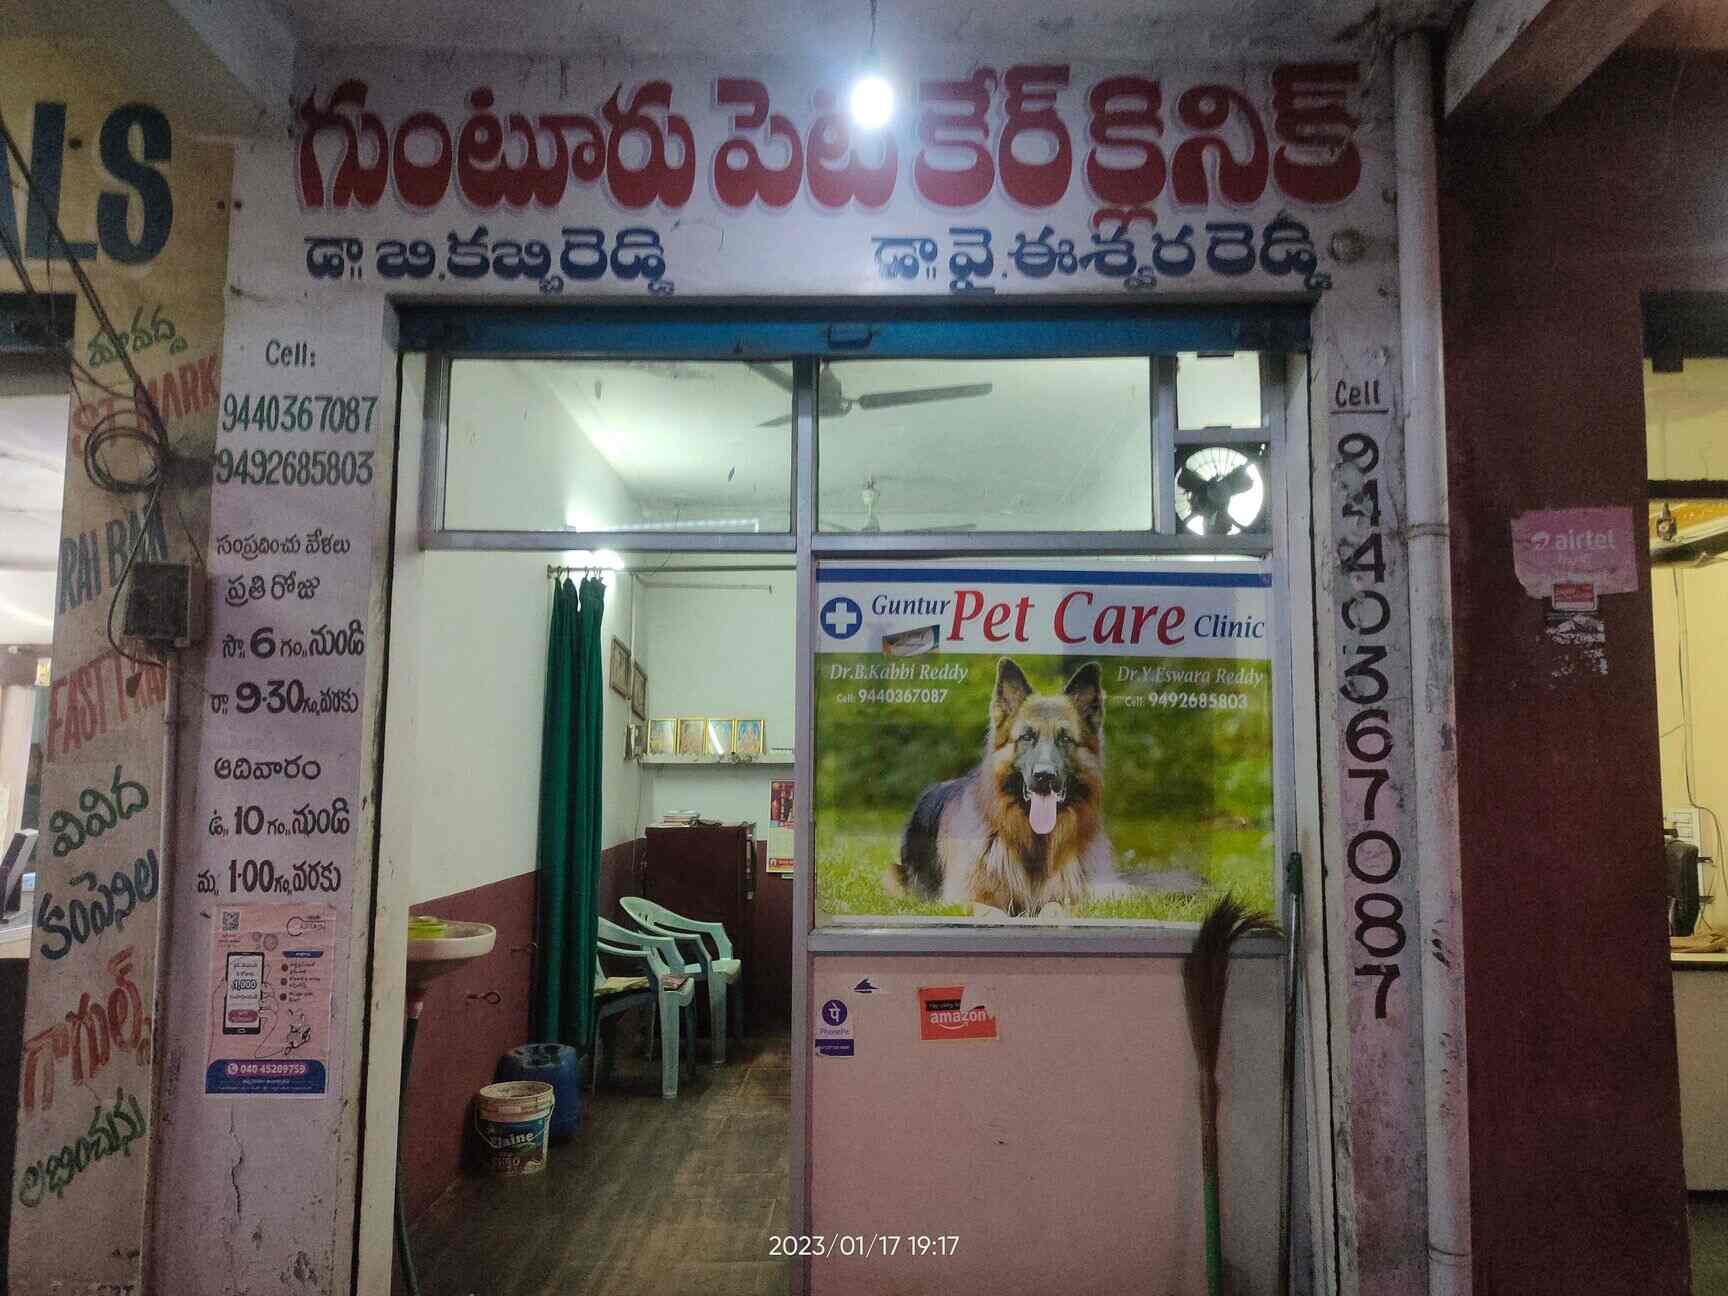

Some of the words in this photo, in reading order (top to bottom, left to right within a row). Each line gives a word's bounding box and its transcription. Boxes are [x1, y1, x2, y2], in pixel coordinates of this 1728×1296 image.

[298, 79, 697, 209] గుంటూరు
[265, 339, 317, 368] Cell:
[1335, 380, 1380, 406] Cell
[221, 396, 379, 434] 9440367087
[214, 449, 374, 486] 9492685803
[215, 534, 301, 561] సంప్రదించు
[305, 528, 351, 554] వేళలు
[1555, 529, 1617, 552] airtel
[224, 574, 266, 607] ప్రతి
[270, 568, 321, 600] రోజు
[872, 594, 951, 616] Guntur
[946, 590, 1036, 642] Pet
[1053, 590, 1186, 646] Care
[1194, 614, 1266, 640] Clinic
[250, 627, 276, 659] 6
[919, 663, 969, 684] Reddy
[1215, 667, 1264, 688] Reddy
[858, 687, 949, 704] 9440367087
[1148, 692, 1249, 710] 9492685803
[214, 755, 321, 780] ఆదివారం
[930, 1010, 986, 1024] amazon
